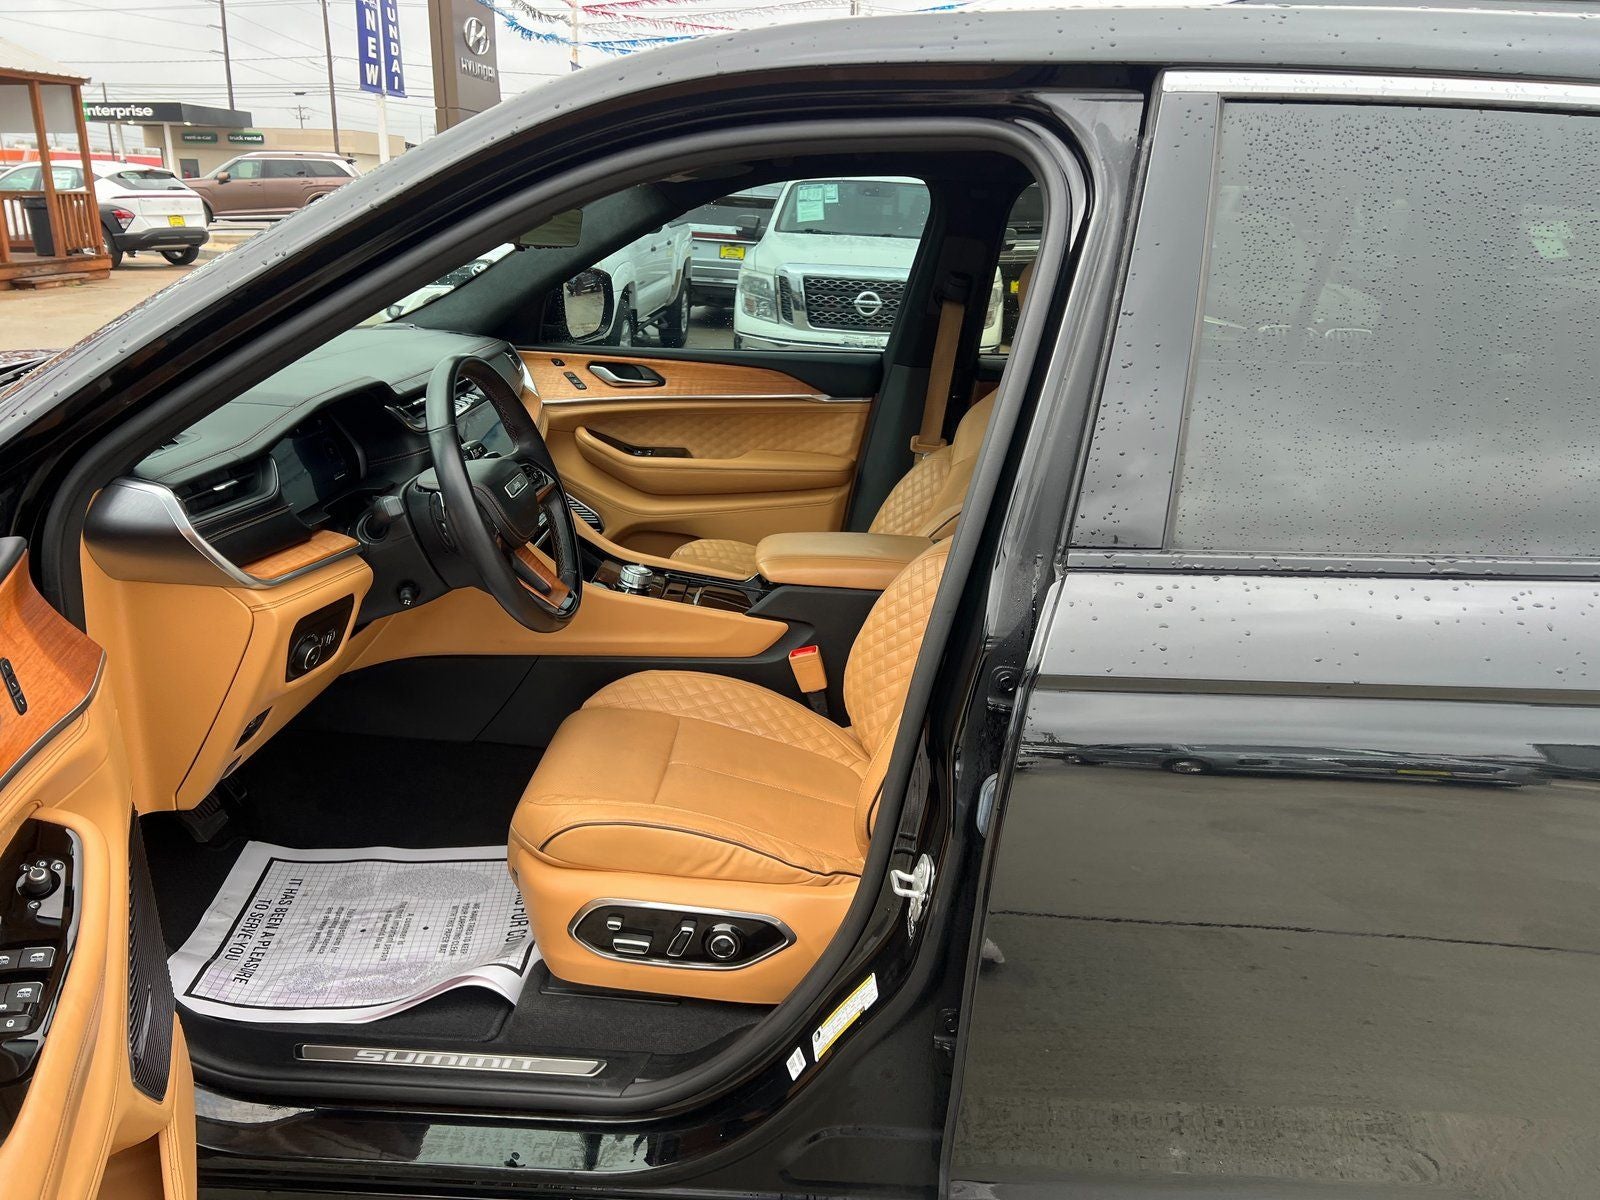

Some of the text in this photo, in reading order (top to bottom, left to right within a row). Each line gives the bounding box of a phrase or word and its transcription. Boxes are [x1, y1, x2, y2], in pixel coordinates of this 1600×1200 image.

[365, 8, 379, 86] NEW
[386, 0, 400, 89] UNDAI
[265, 908, 288, 929] BEEN
[278, 888, 299, 906] HAS
[224, 899, 272, 961] TO SERVE YOU
[232, 940, 271, 984] PLEASURE
[354, 1049, 541, 1070] SUMMIT
